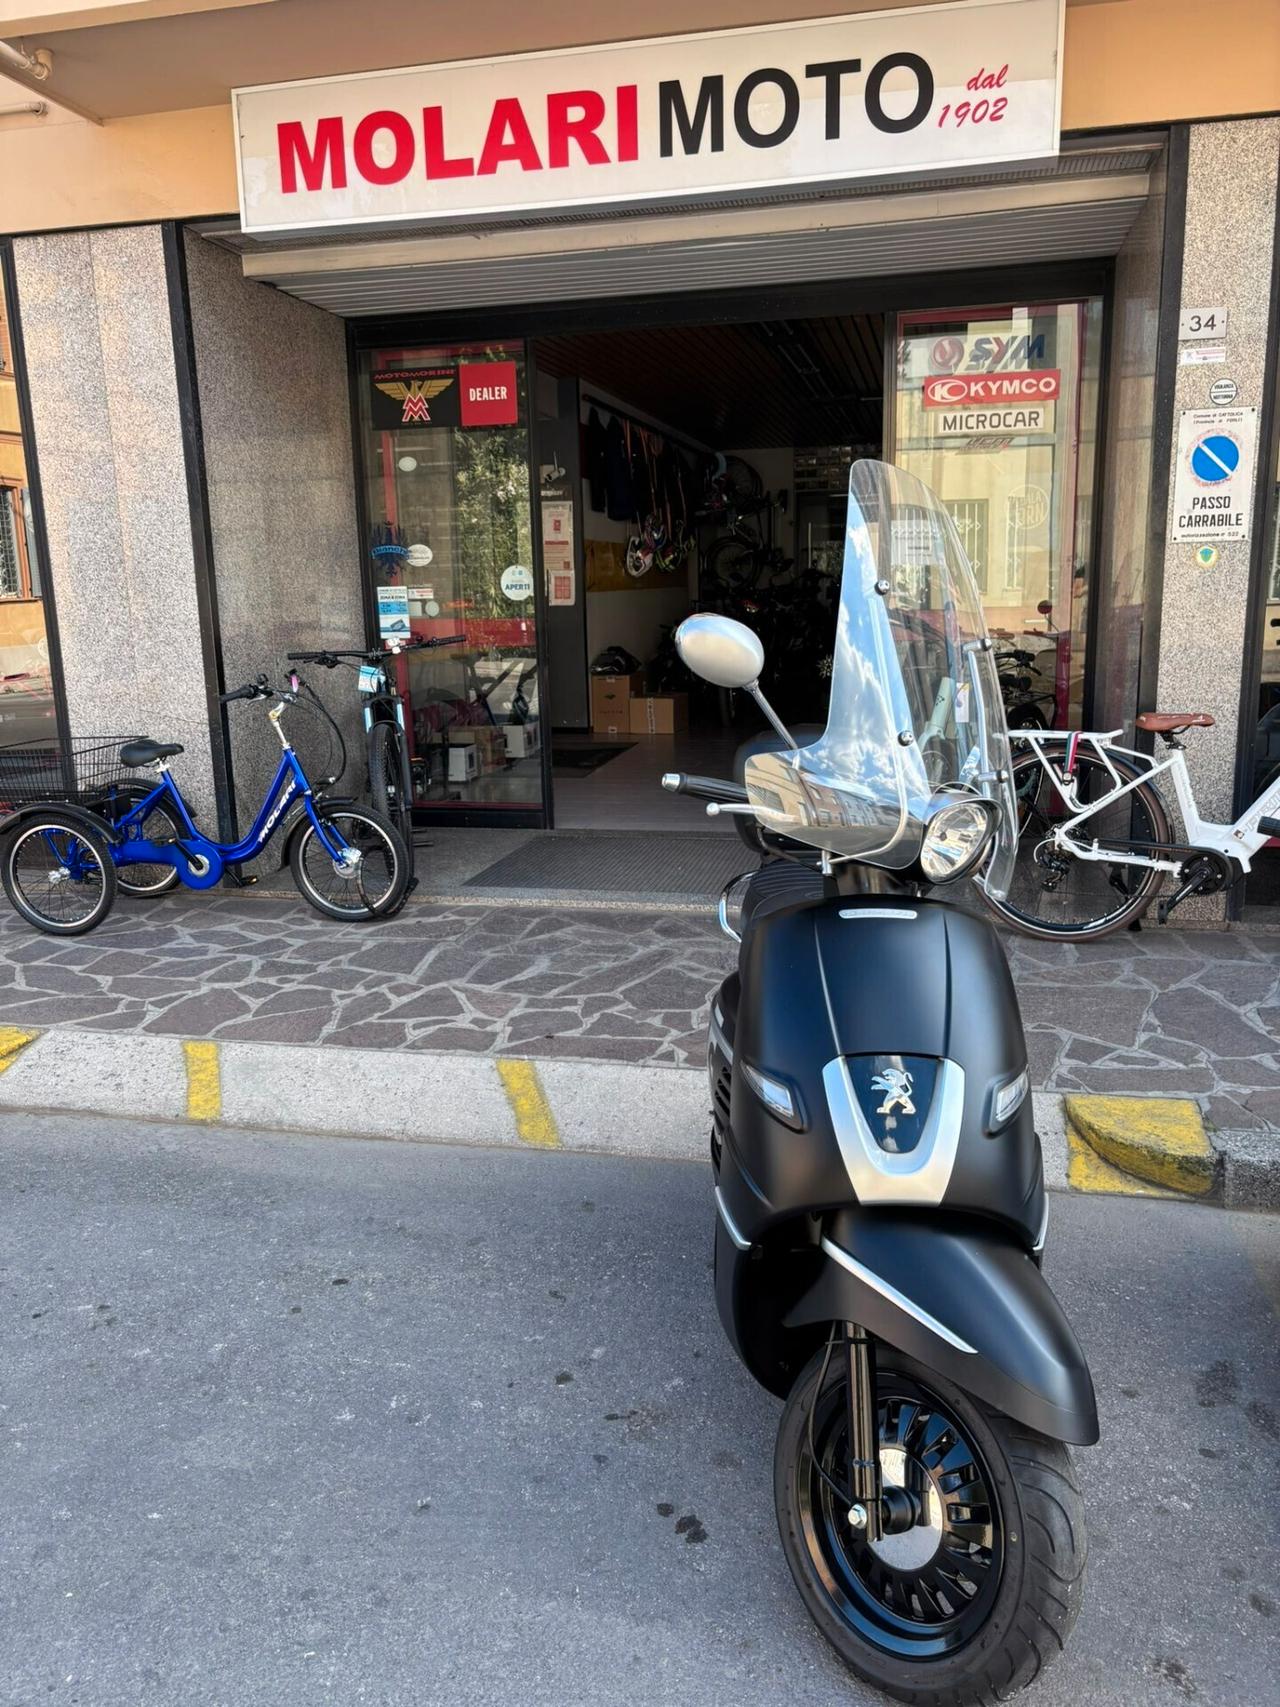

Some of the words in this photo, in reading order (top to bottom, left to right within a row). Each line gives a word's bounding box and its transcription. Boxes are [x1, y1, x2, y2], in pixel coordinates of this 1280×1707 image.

[966, 64, 1009, 92] dal
[277, 84, 639, 194] MOLARI
[658, 51, 934, 158] MOTO
[938, 97, 1008, 128] 1902
[1189, 314, 1217, 332] 34
[969, 334, 1045, 364] SYM
[469, 386, 508, 402] DEALER
[969, 377, 1056, 397] KYMCO
[943, 411, 1040, 431] MICROCAR
[1192, 496, 1231, 510] PASSO
[1178, 513, 1244, 528] CARRABILE
